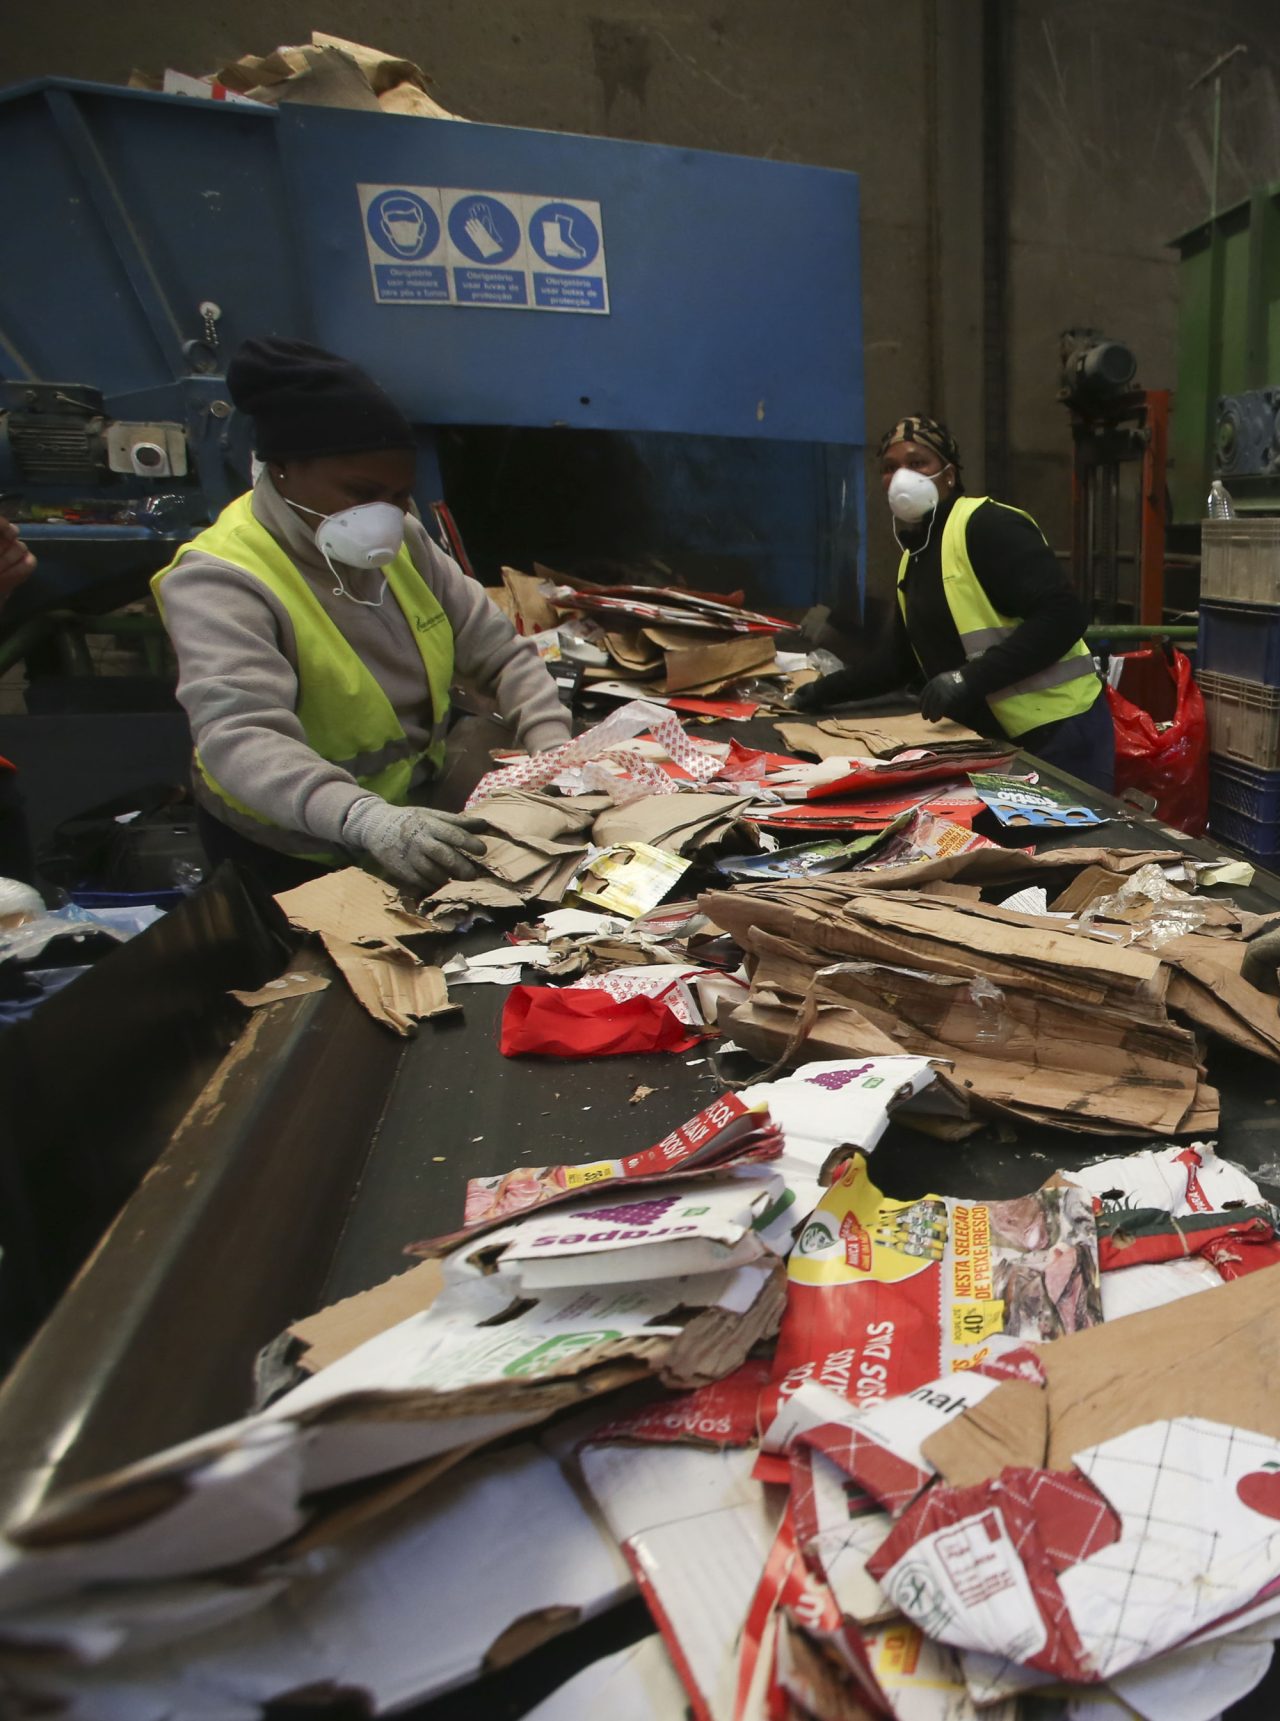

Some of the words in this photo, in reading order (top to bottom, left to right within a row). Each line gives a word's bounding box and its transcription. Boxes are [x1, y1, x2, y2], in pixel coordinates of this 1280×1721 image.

[462, 282, 480, 290] usar
[484, 282, 506, 290] luvas
[508, 283, 519, 291] de
[466, 270, 514, 282] Obrigatório
[545, 276, 592, 288] Obrigatório
[541, 287, 558, 295] usar
[561, 288, 585, 297] botas
[587, 289, 598, 298] de
[972, 1206, 988, 1247] FRESCO
[973, 1248, 991, 1281] PEIXE
[955, 1260, 971, 1297] NESTA
[975, 1284, 991, 1300] DE
[862, 1321, 895, 1361] DIAS
[820, 1348, 855, 1396] AIXOS
[909, 1388, 967, 1414] nah
